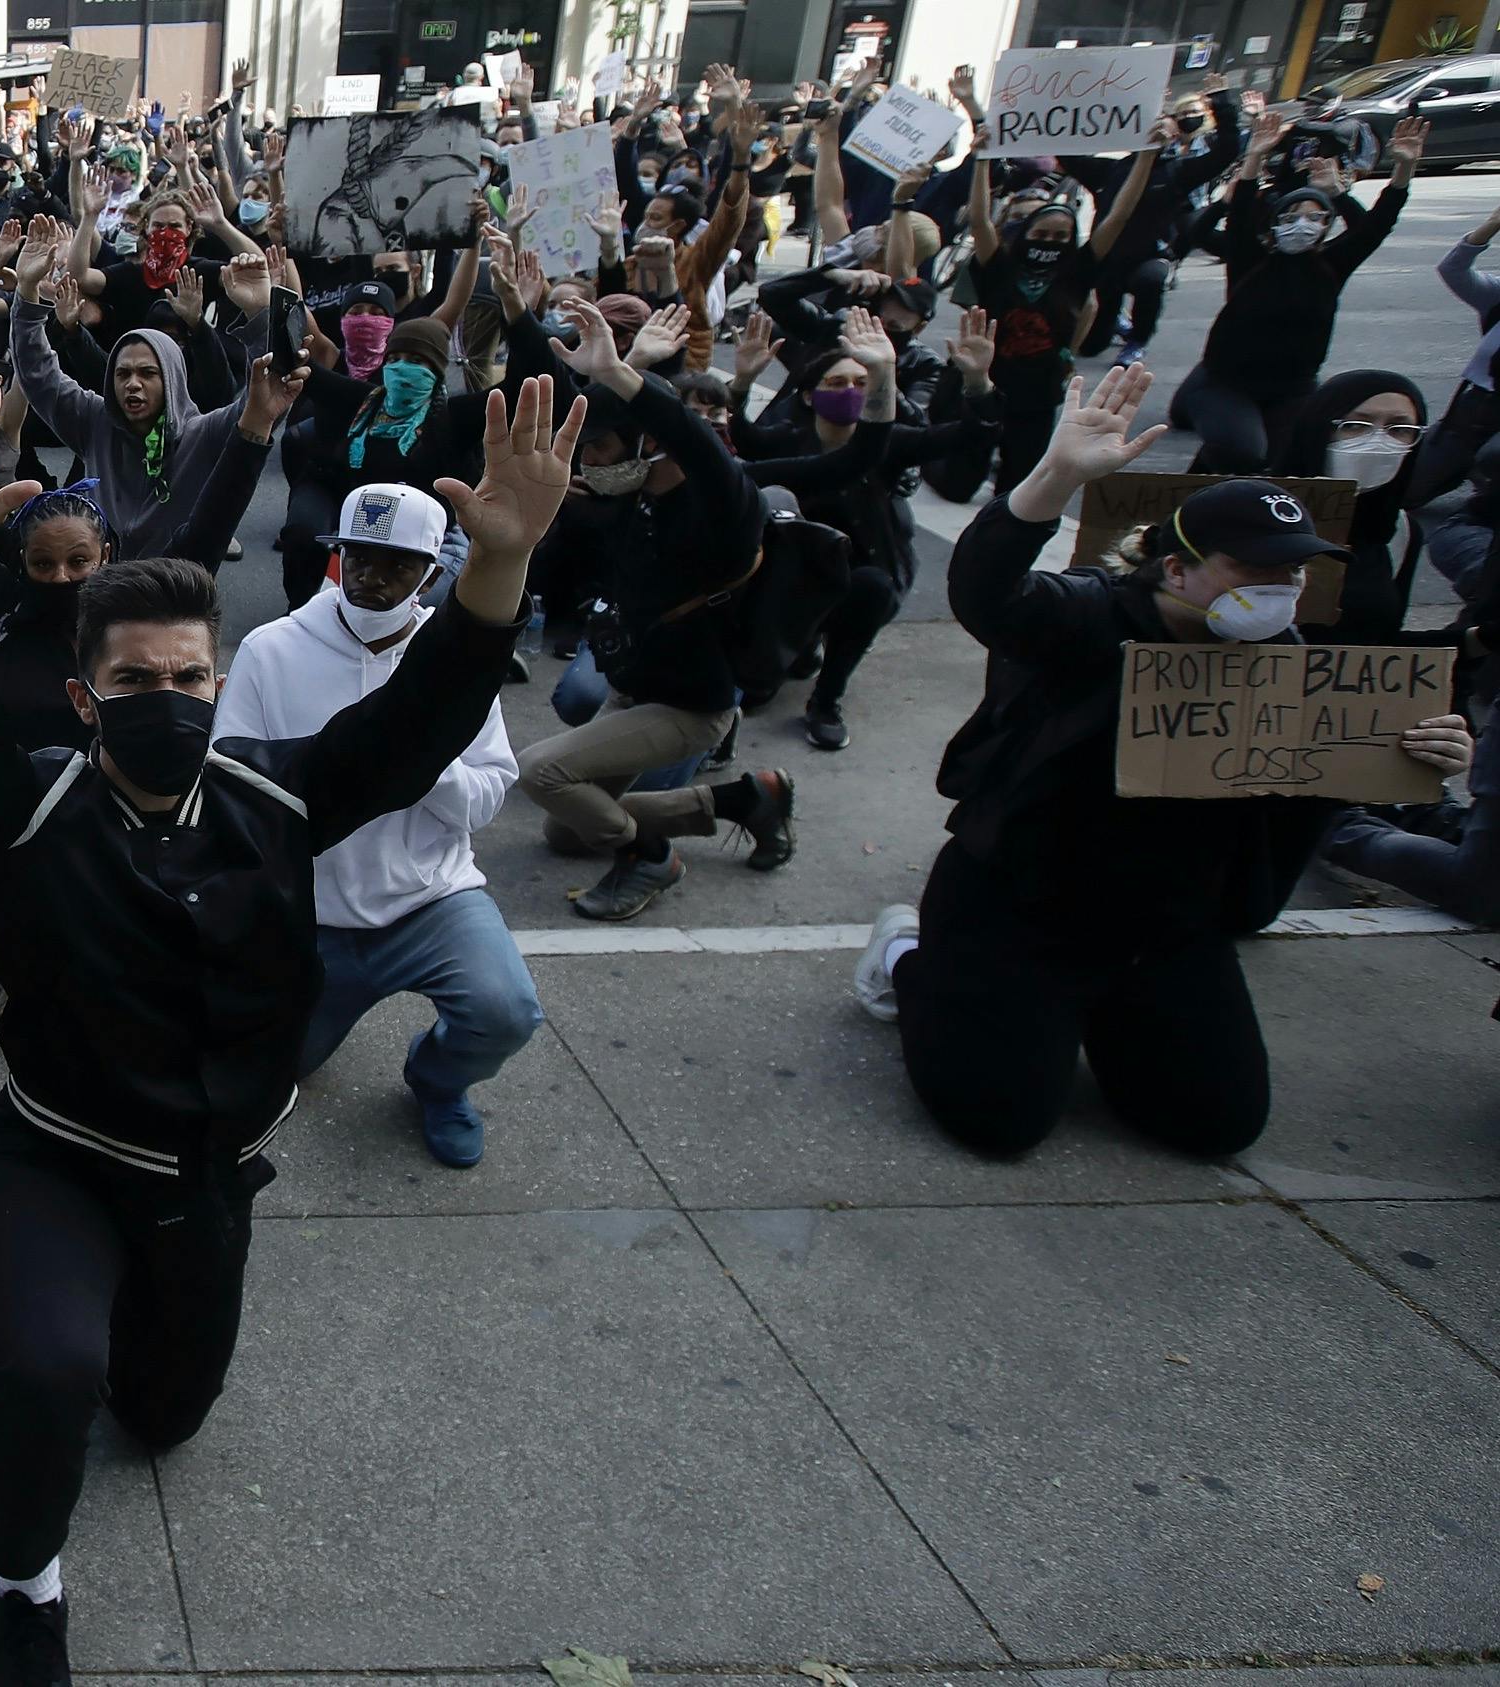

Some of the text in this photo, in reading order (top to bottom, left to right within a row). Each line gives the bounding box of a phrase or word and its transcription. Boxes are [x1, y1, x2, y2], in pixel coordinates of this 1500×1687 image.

[26, 17, 52, 30] 855
[424, 22, 453, 37] OPEN
[60, 51, 126, 77] BLACK
[59, 71, 117, 97] LIVES
[47, 90, 124, 116] MATTER
[888, 90, 920, 118] WHITE
[999, 104, 1142, 145] RACISM
[1132, 648, 1438, 698] PROTECT BLACK
[1132, 700, 1400, 742] LIVES AT ALL
[1212, 746, 1333, 782] COSTS
